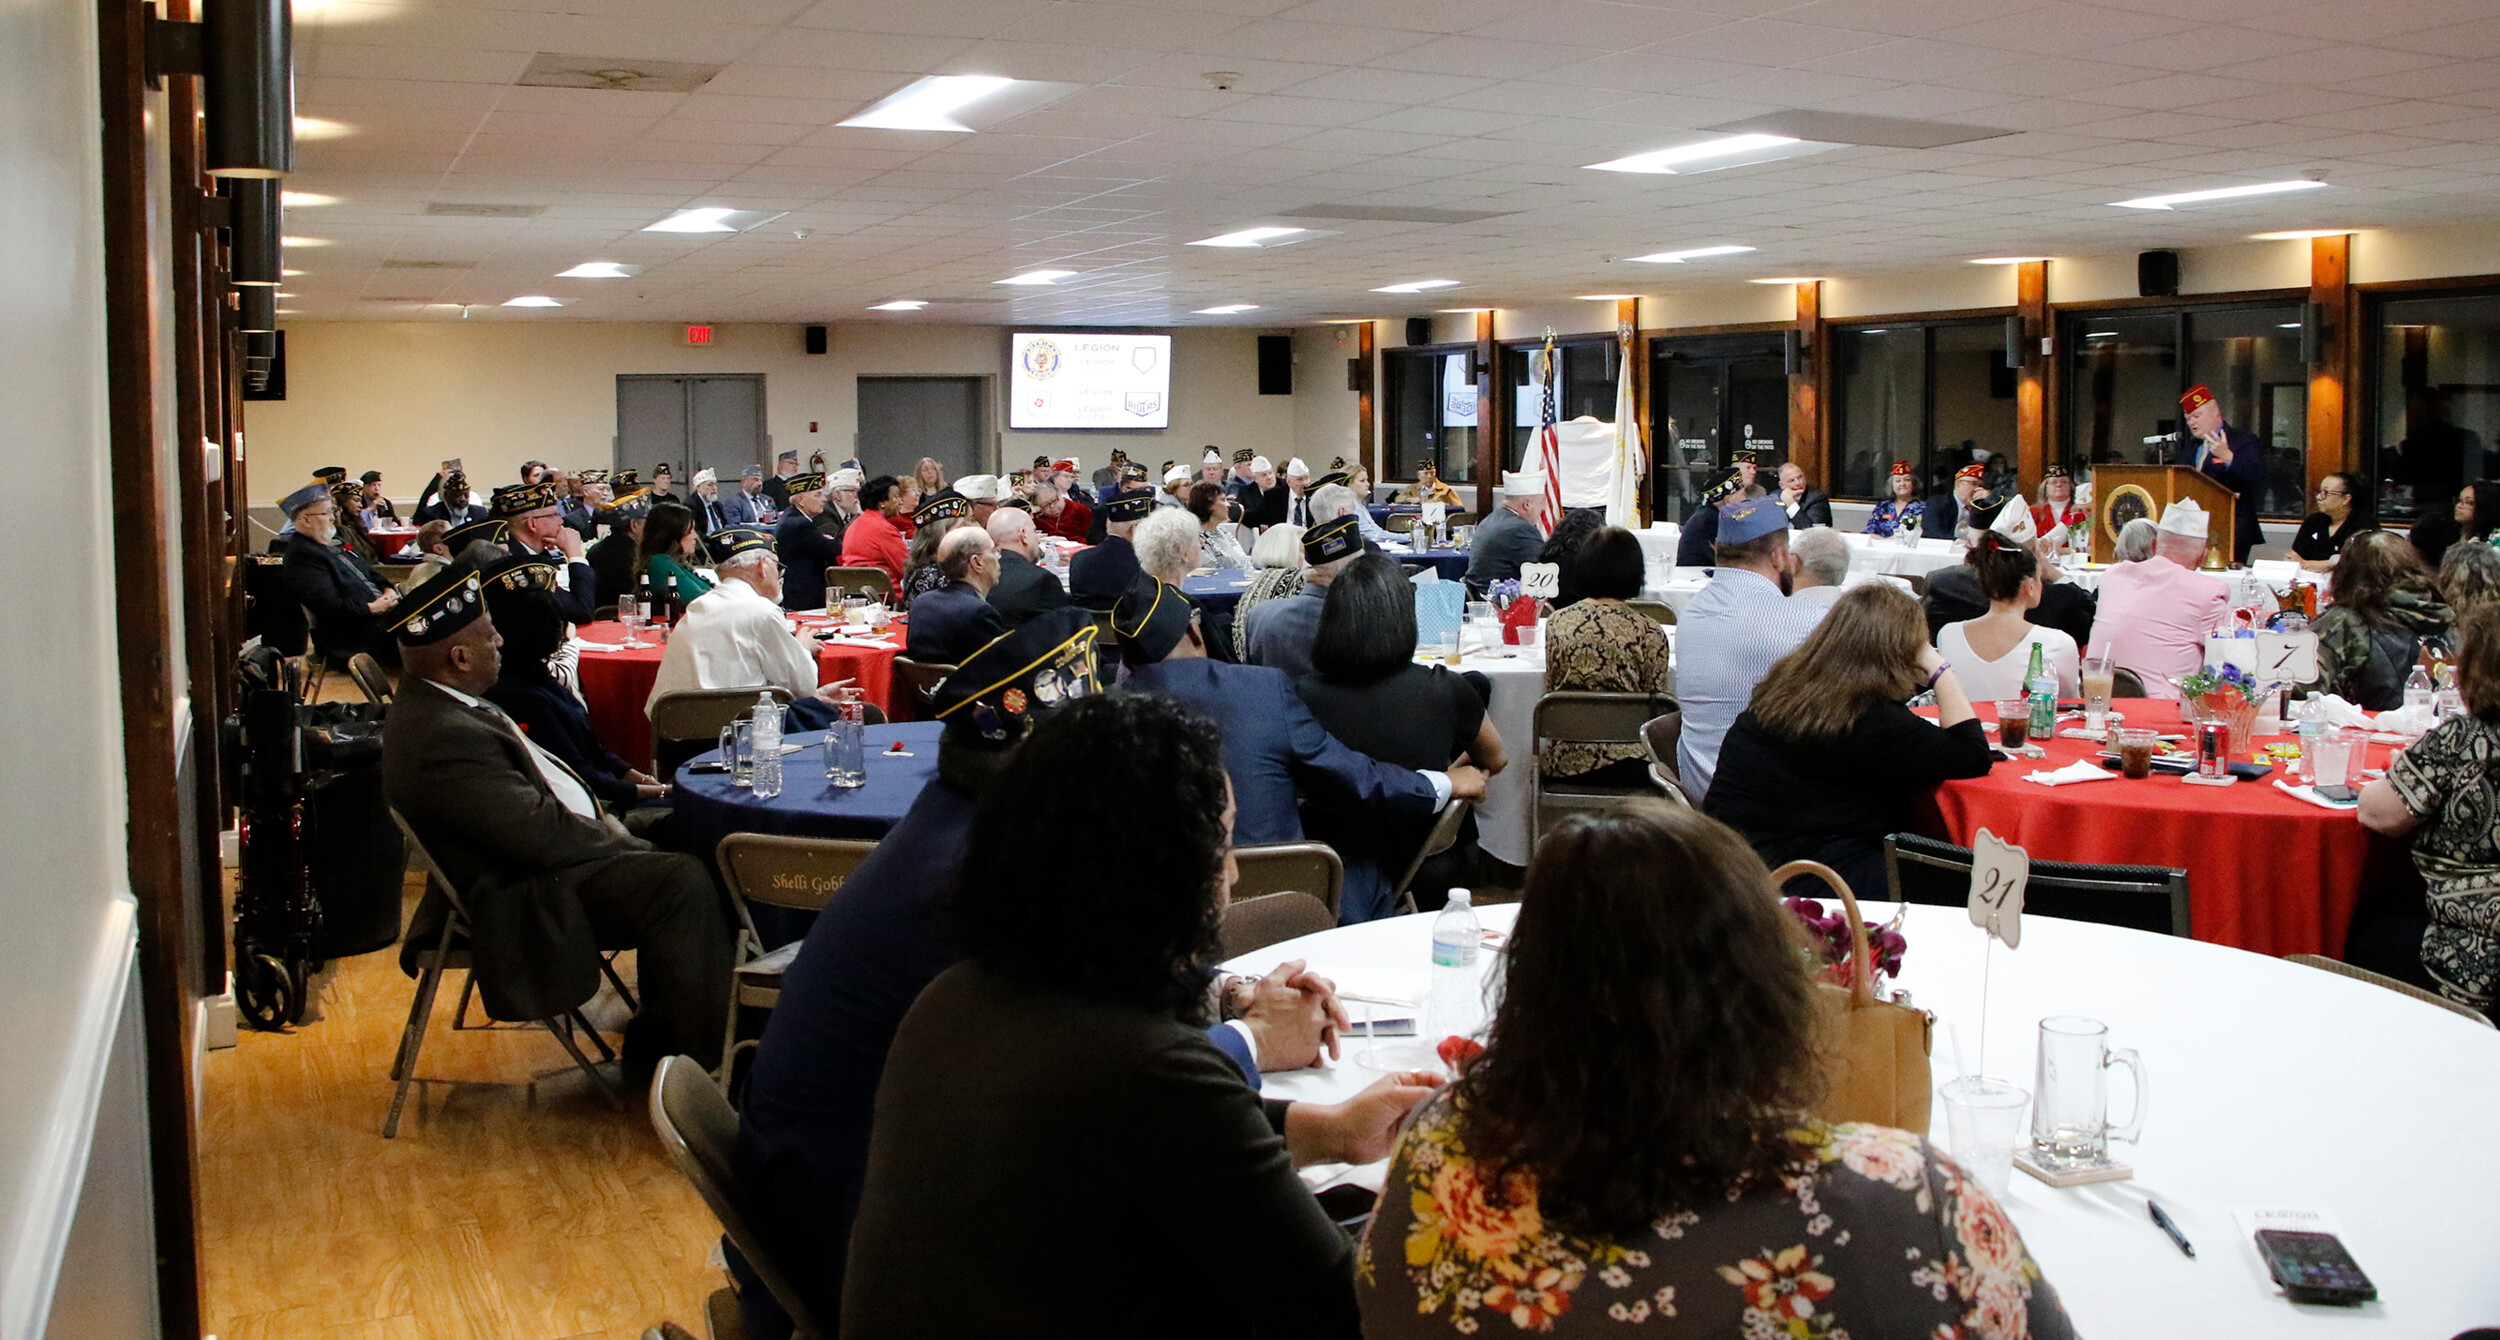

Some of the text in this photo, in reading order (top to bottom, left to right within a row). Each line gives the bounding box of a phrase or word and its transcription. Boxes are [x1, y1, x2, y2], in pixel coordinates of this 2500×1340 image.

[688, 326, 711, 343] EXIT
[1075, 344, 1120, 352] LEGION
[1128, 401, 1157, 413] RIDERS
[1526, 572, 1554, 588] 20
[2272, 644, 2300, 669] 7
[772, 873, 807, 890] Shelli
[1978, 867, 2016, 909] 21
